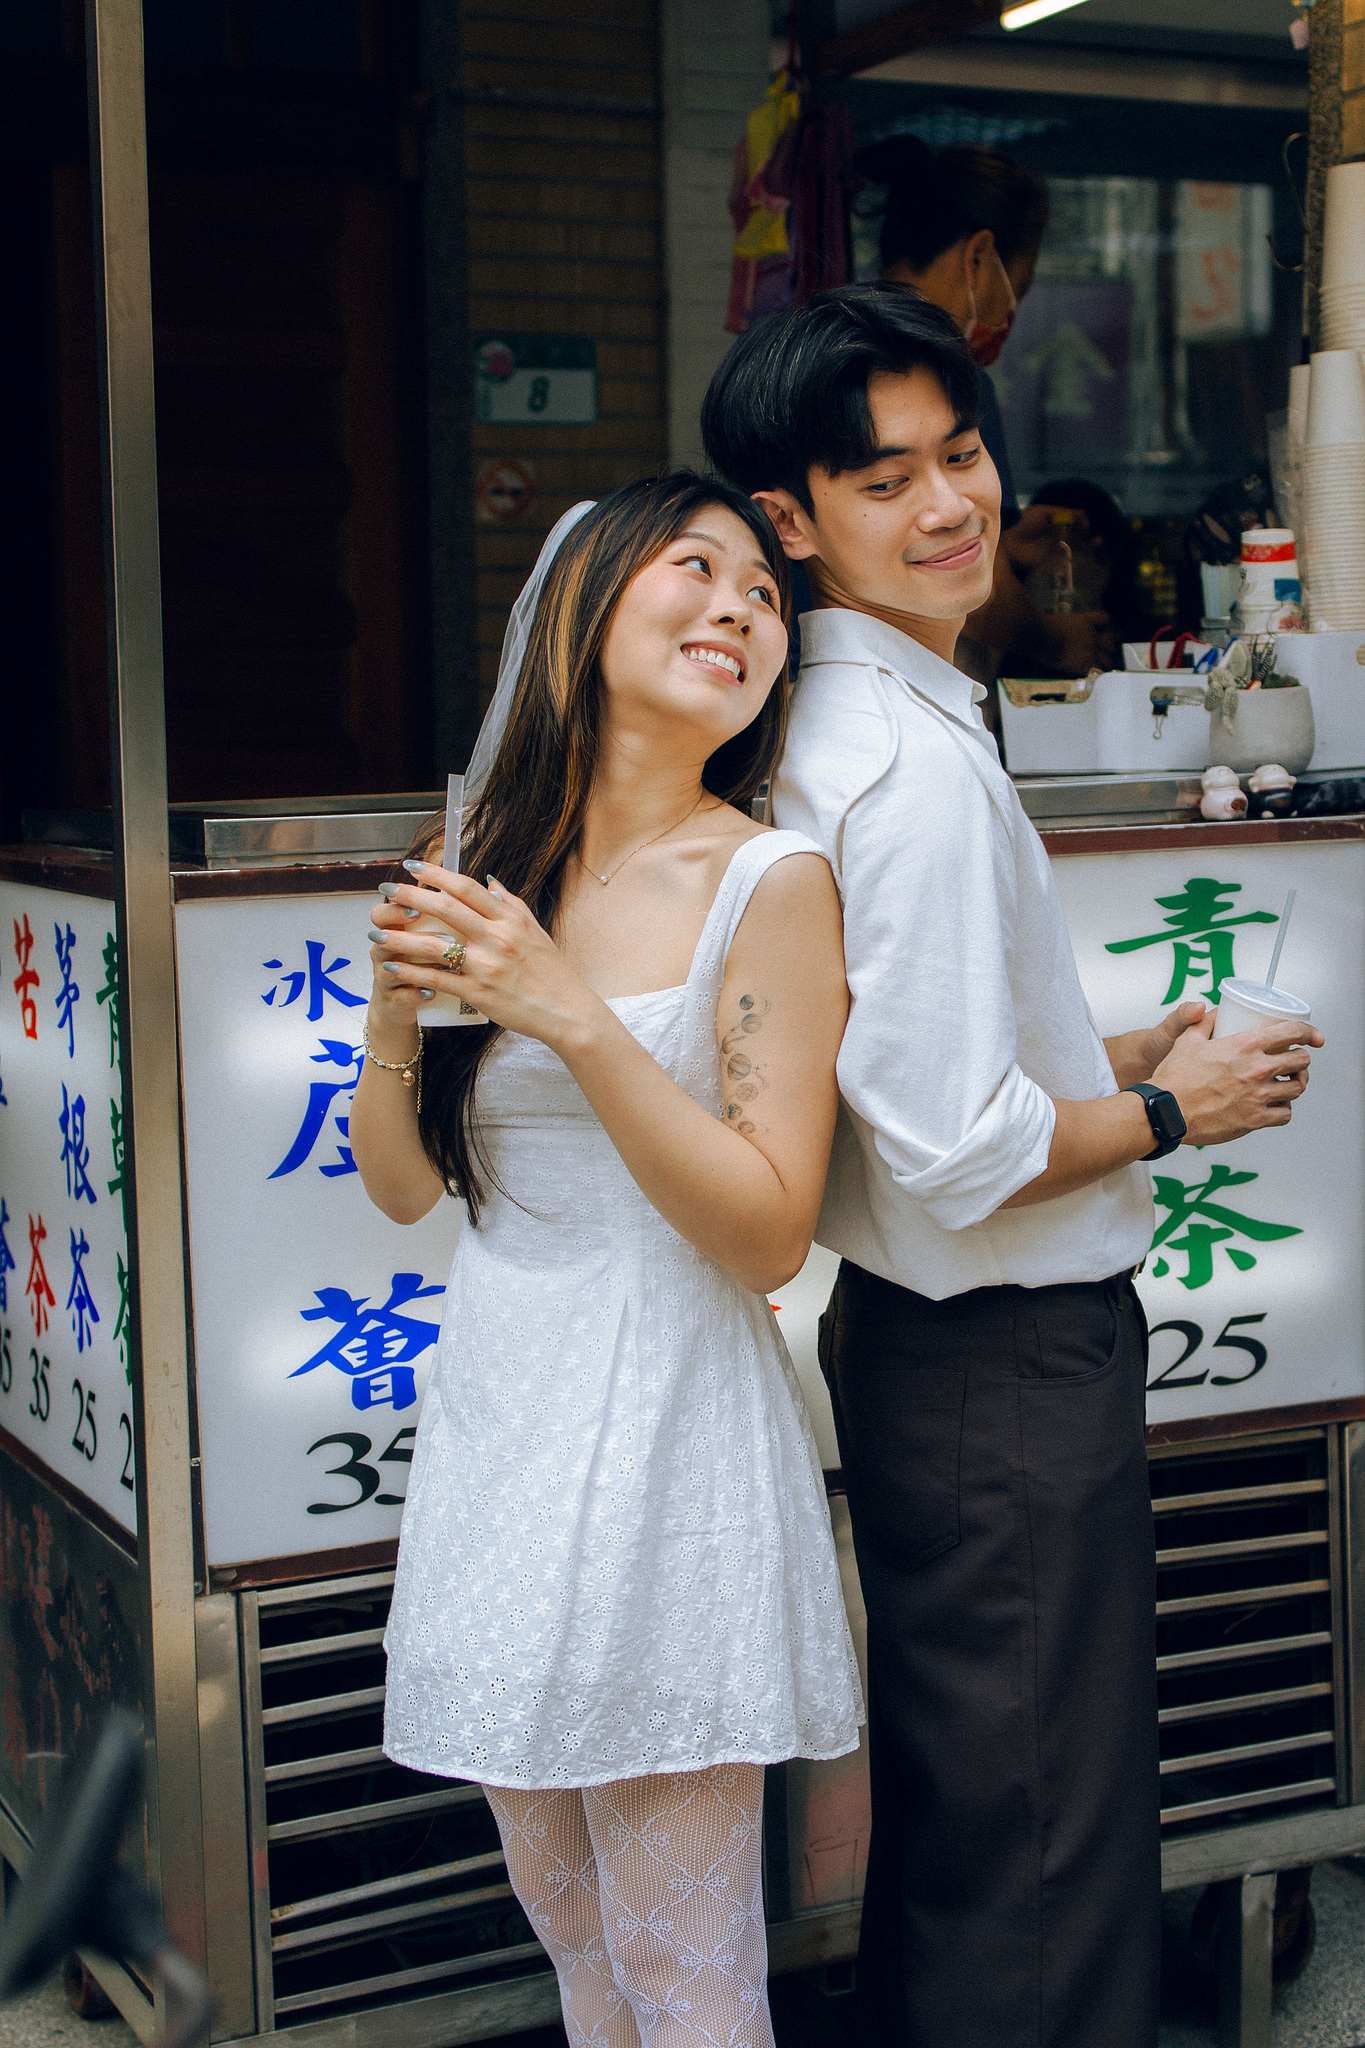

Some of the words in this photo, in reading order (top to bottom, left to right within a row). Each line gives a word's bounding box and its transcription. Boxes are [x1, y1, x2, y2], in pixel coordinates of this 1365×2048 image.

[527, 375, 550, 413] 8
[1104, 877, 1305, 1290] 青茶
[53, 921, 101, 1354] 茅根茶
[28, 1347, 51, 1423] 35
[1145, 1312, 1269, 1392] 25
[71, 1377, 98, 1462] 25
[305, 1426, 418, 1515] 35
